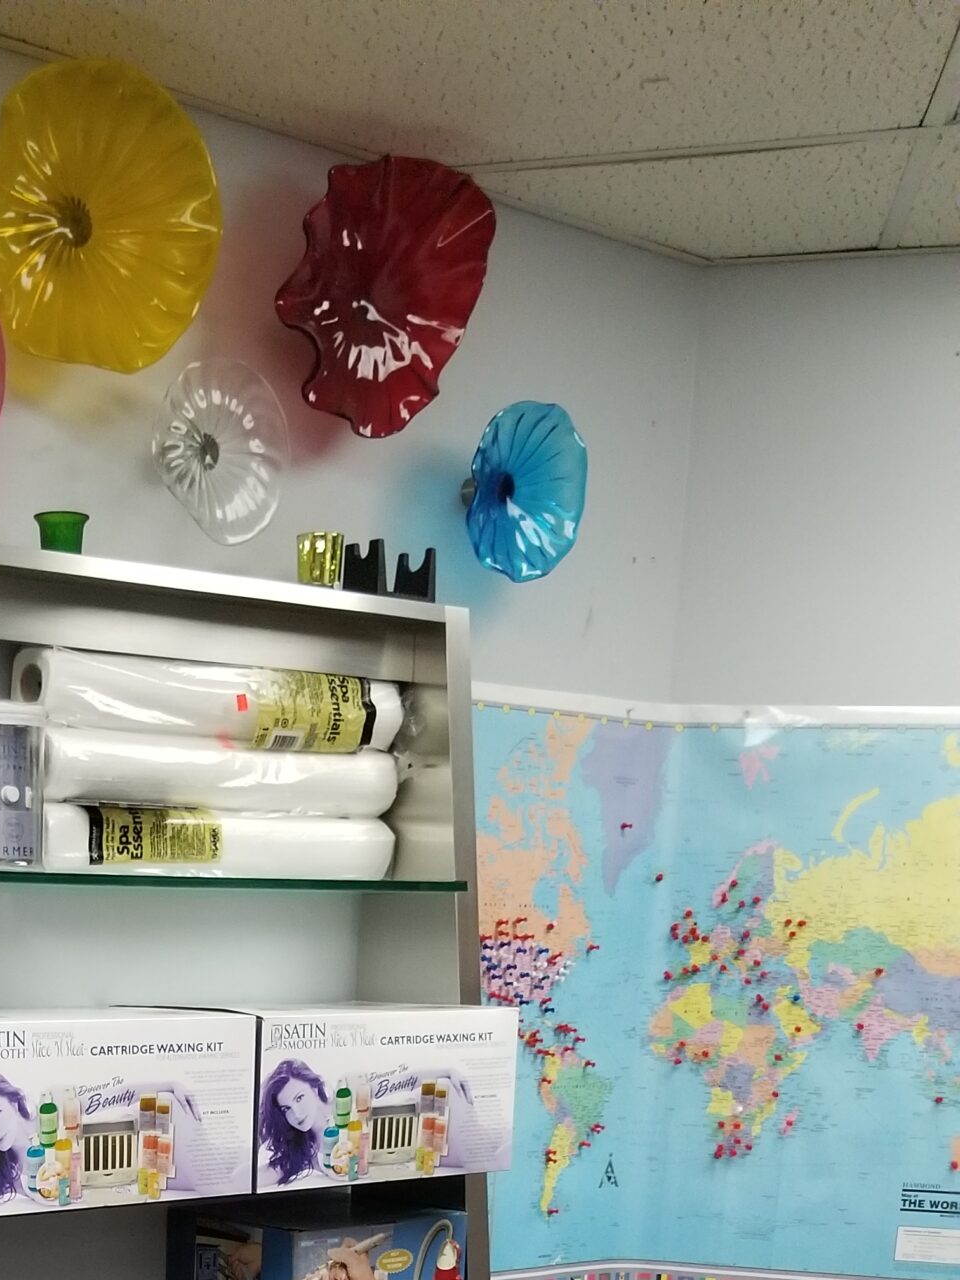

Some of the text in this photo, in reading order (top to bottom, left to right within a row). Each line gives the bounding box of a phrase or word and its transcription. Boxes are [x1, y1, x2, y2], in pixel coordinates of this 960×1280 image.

[337, 677, 350, 703] Spa
[117, 825, 132, 855] Spa
[283, 1023, 326, 1039] SATIN
[380, 1034, 435, 1046] CARTRIDGE
[436, 1033, 476, 1043] WAXING
[478, 1032, 493, 1041] KIT
[90, 1044, 155, 1056] CARTRIDGE
[156, 1042, 204, 1054] WAXING
[206, 1042, 224, 1052] KIT
[283, 1038, 326, 1050] SMOOTH
[374, 1075, 418, 1099] Beauty
[85, 1089, 135, 1115] Beauty
[901, 1199, 960, 1210] THE WOR
